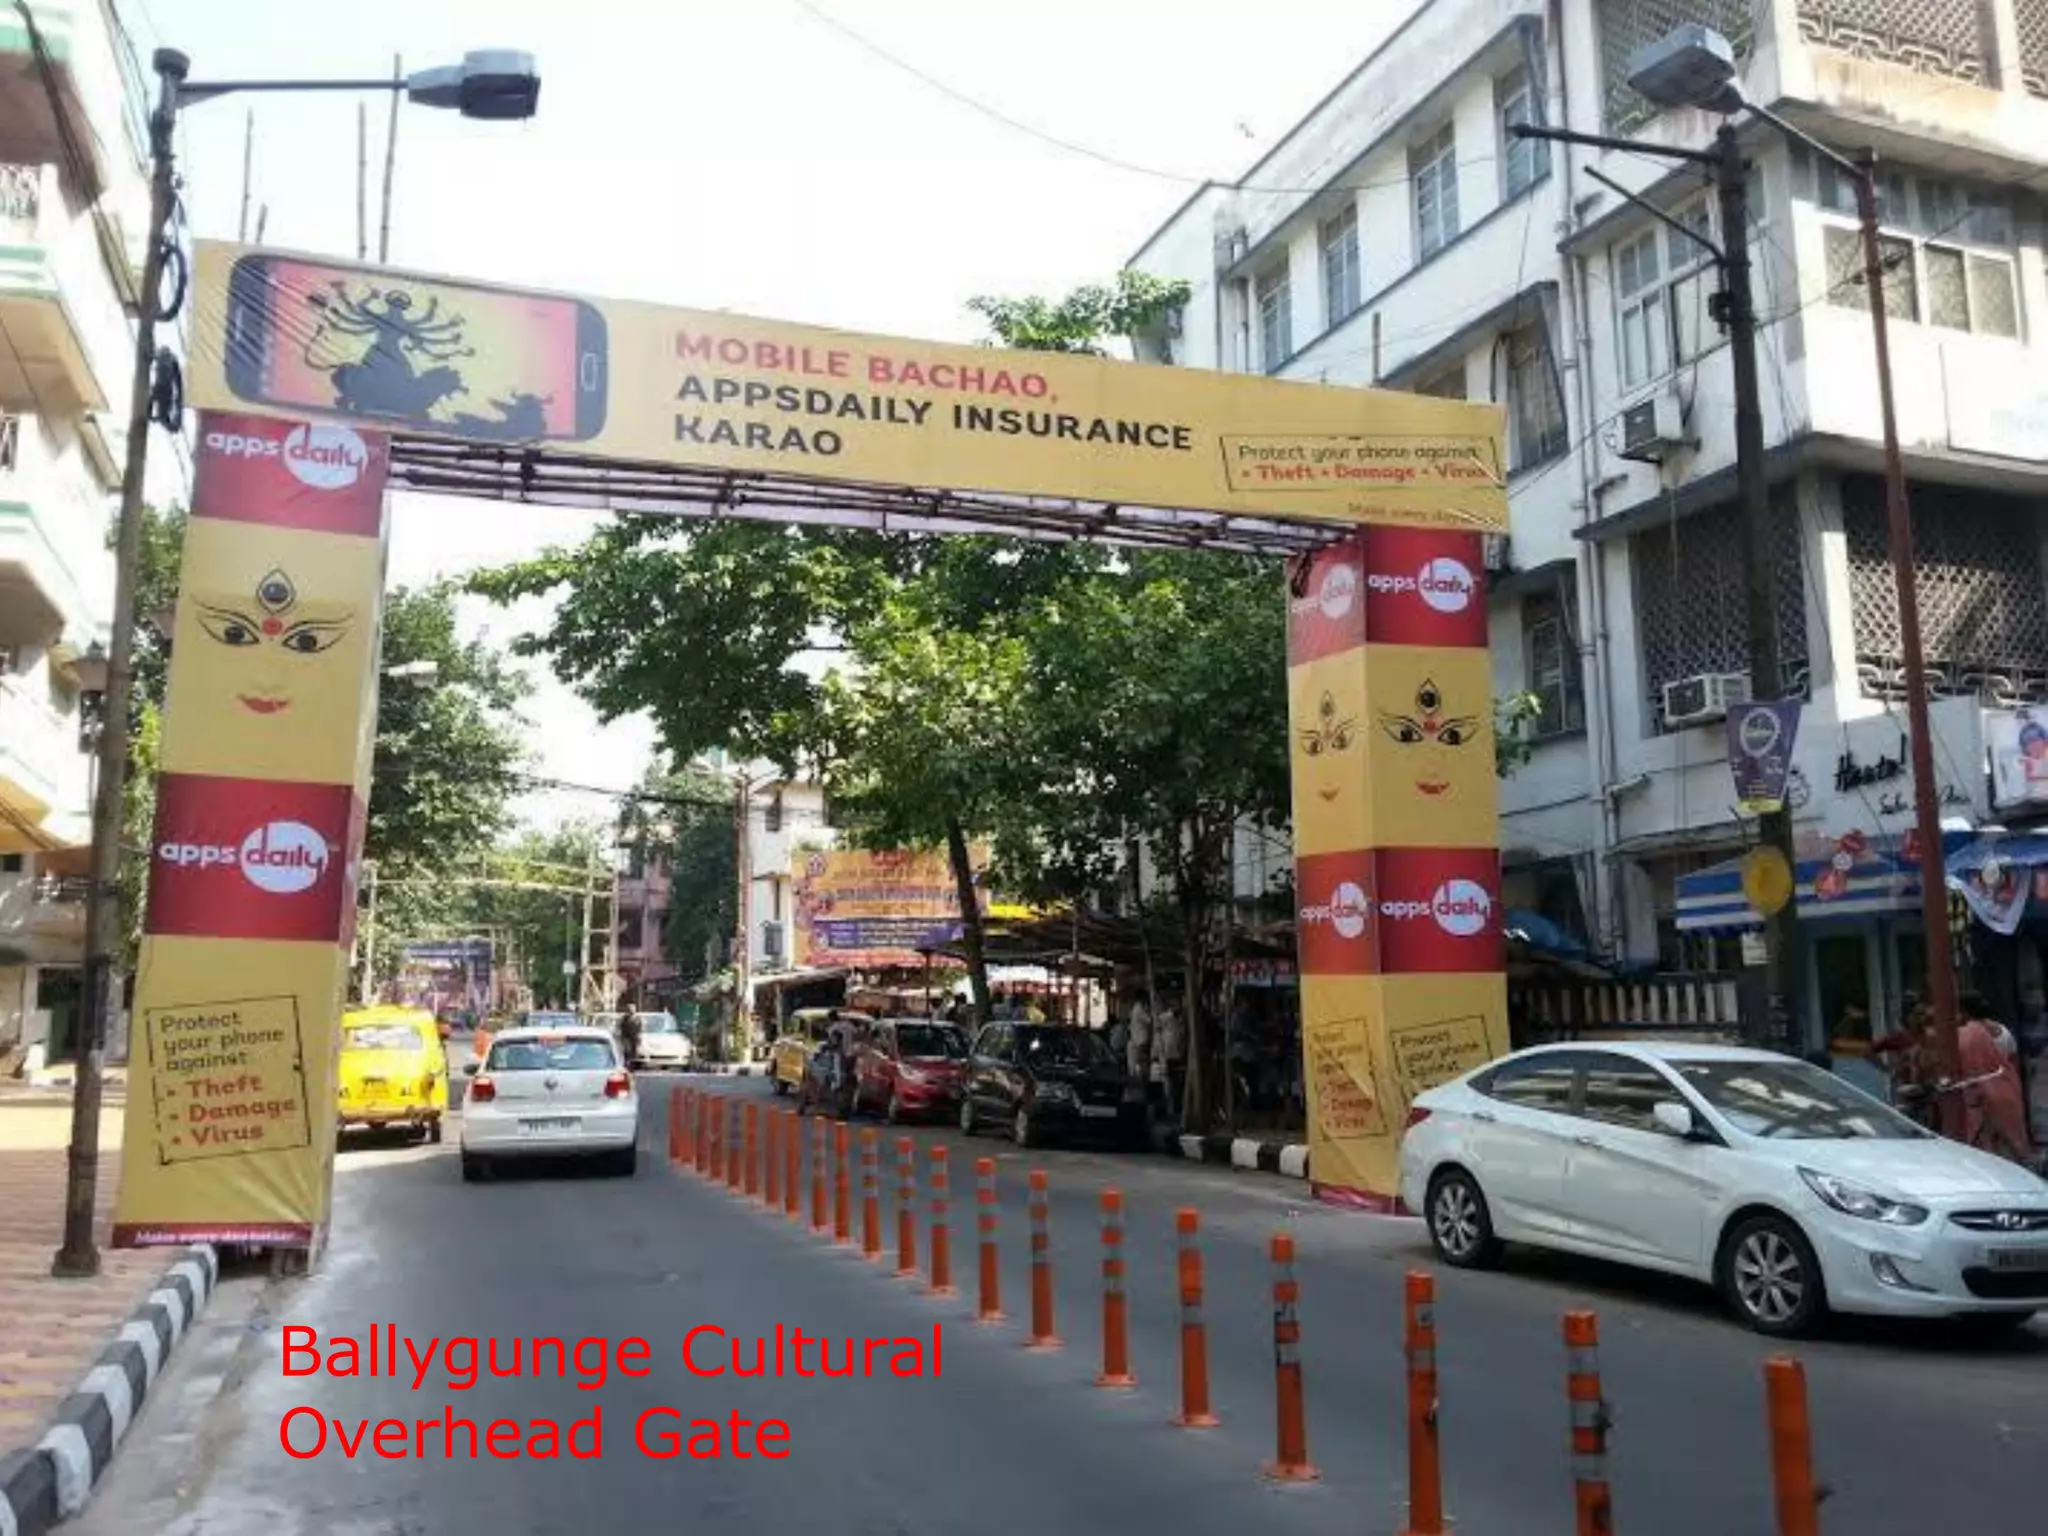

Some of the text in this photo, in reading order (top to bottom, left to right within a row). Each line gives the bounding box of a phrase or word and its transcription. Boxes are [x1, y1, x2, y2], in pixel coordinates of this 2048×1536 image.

[675, 332, 1058, 405] MOBILE BACHAO,
[676, 376, 1193, 451] APPSDAILY INSURANCE
[675, 413, 842, 456] KARAO
[206, 423, 366, 480] apps daily
[1238, 444, 1306, 461] Protect
[1311, 447, 1352, 463] your
[1357, 444, 1405, 462] phone
[1259, 462, 1489, 482] Theft Damage Virus
[1368, 560, 1472, 597] apps daily
[159, 826, 325, 880] apps daily
[1381, 884, 1490, 921] apps daily
[160, 1011, 242, 1033] Protect
[163, 1027, 285, 1056] your phone
[166, 1050, 249, 1074] against
[185, 1075, 263, 1098] Theft
[188, 1098, 297, 1123] Damage
[191, 1123, 265, 1146] Virus
